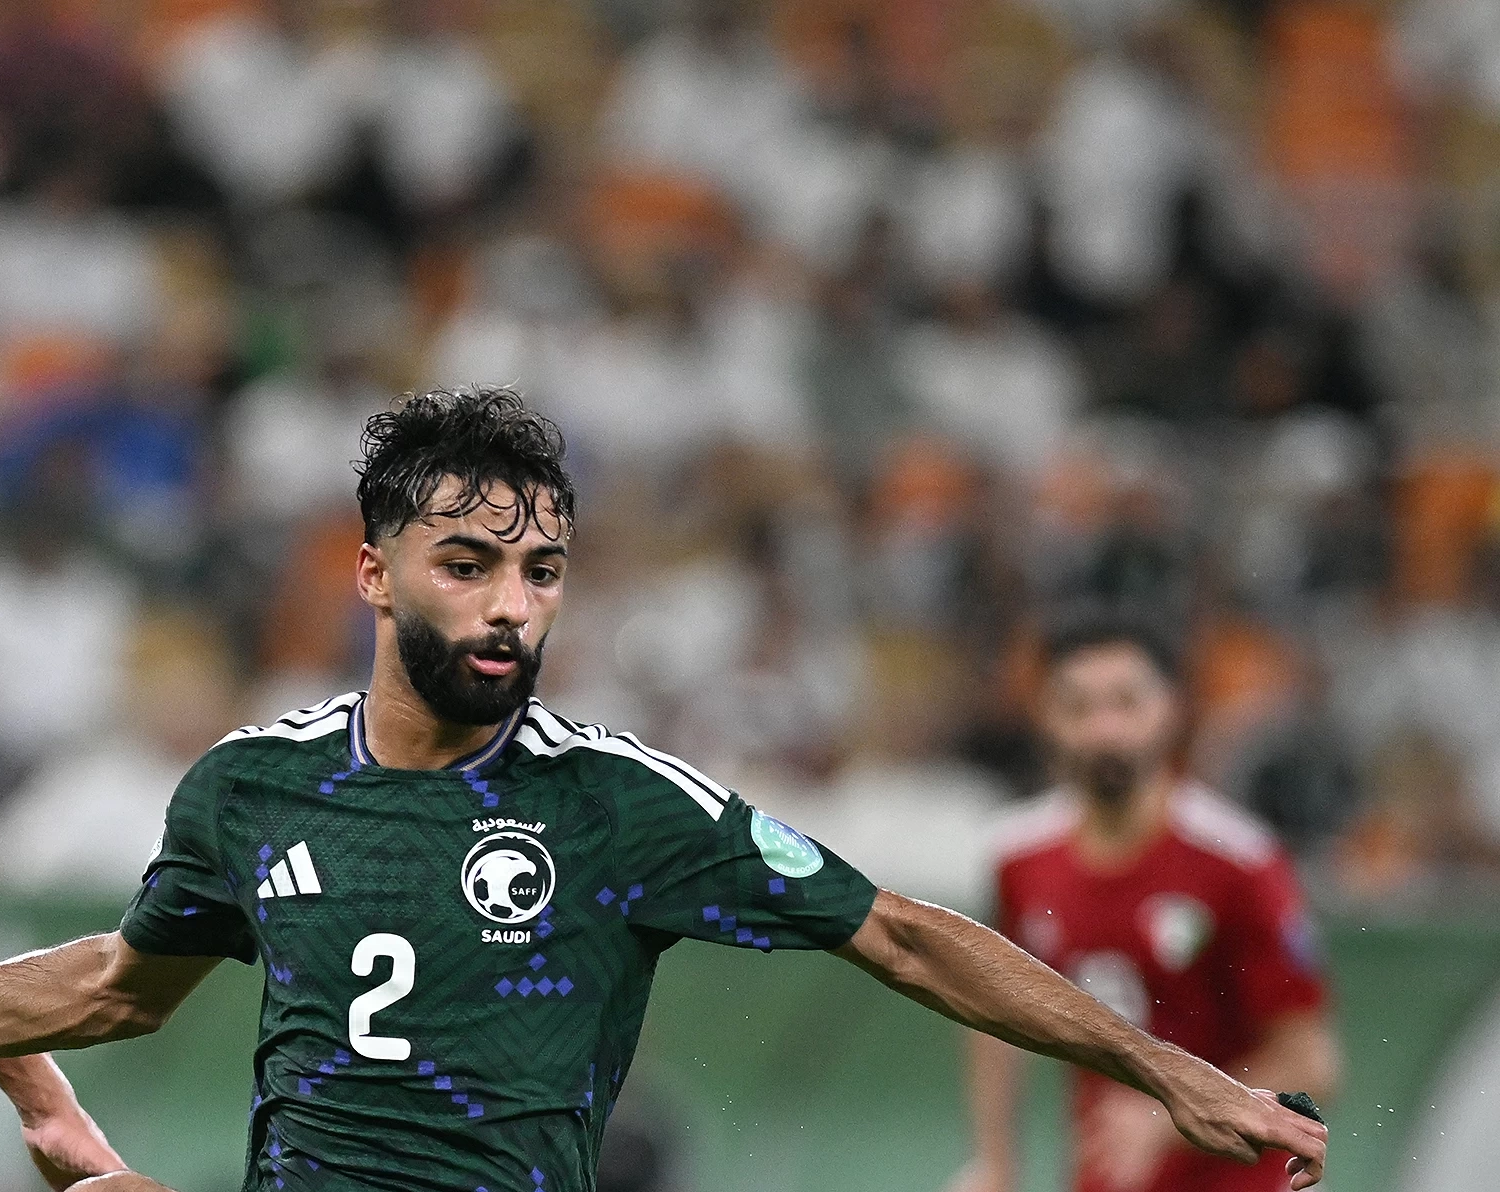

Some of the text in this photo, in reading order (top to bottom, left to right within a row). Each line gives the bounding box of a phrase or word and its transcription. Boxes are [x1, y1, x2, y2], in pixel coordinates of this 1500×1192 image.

[472, 817, 547, 835] السعودية
[511, 887, 537, 896] SAFF
[481, 929, 531, 944] SAUDI
[348, 932, 416, 1061] 2
